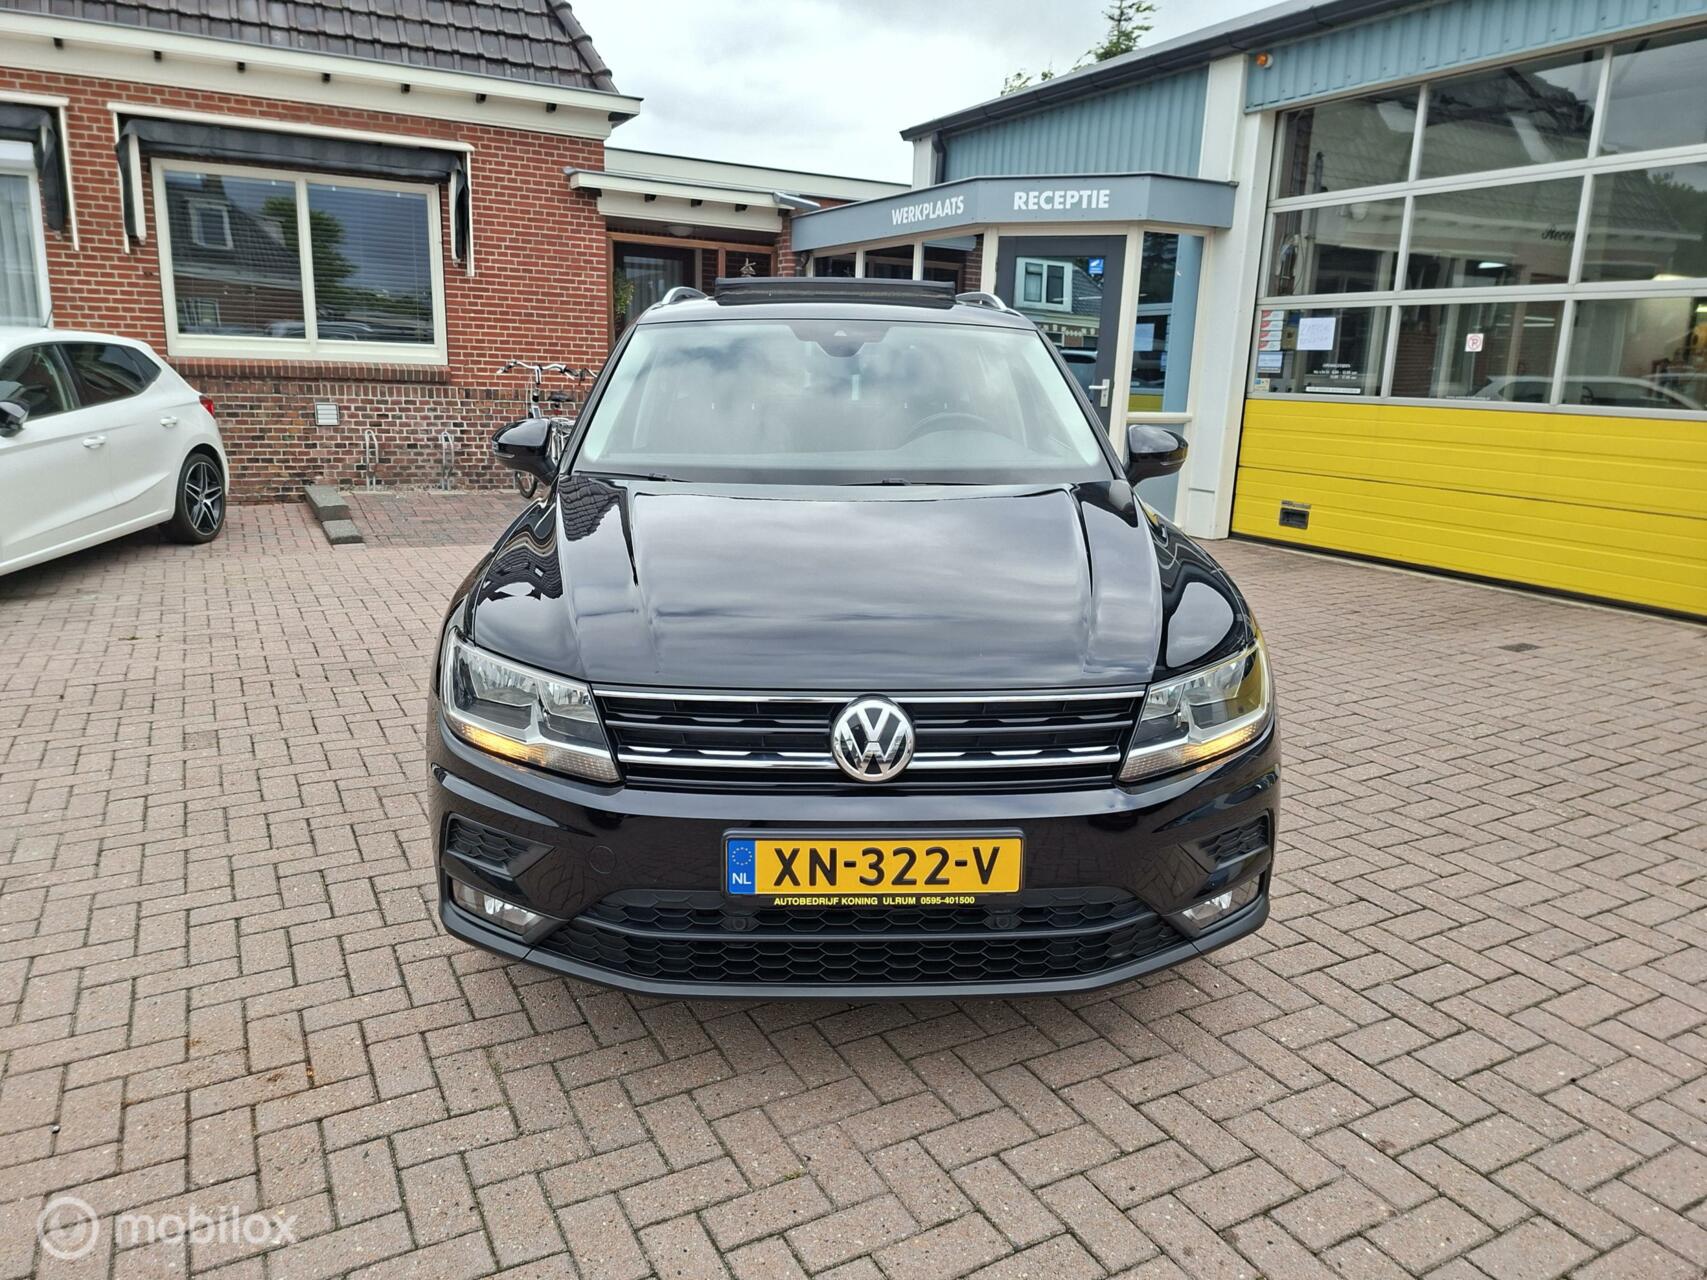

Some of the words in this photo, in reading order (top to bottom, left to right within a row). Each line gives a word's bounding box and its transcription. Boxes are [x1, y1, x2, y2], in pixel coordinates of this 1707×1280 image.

[891, 196, 965, 225] WERKPLAATS
[1013, 189, 1111, 210] RECEPTIE
[838, 700, 909, 779] VW
[732, 873, 752, 885] NL
[773, 846, 1001, 887] XN-322-V
[773, 897, 840, 906] AUTOBEDRIJF
[841, 896, 878, 905] KONING
[883, 896, 916, 905] ULRUM
[920, 896, 976, 905] 0595-401500
